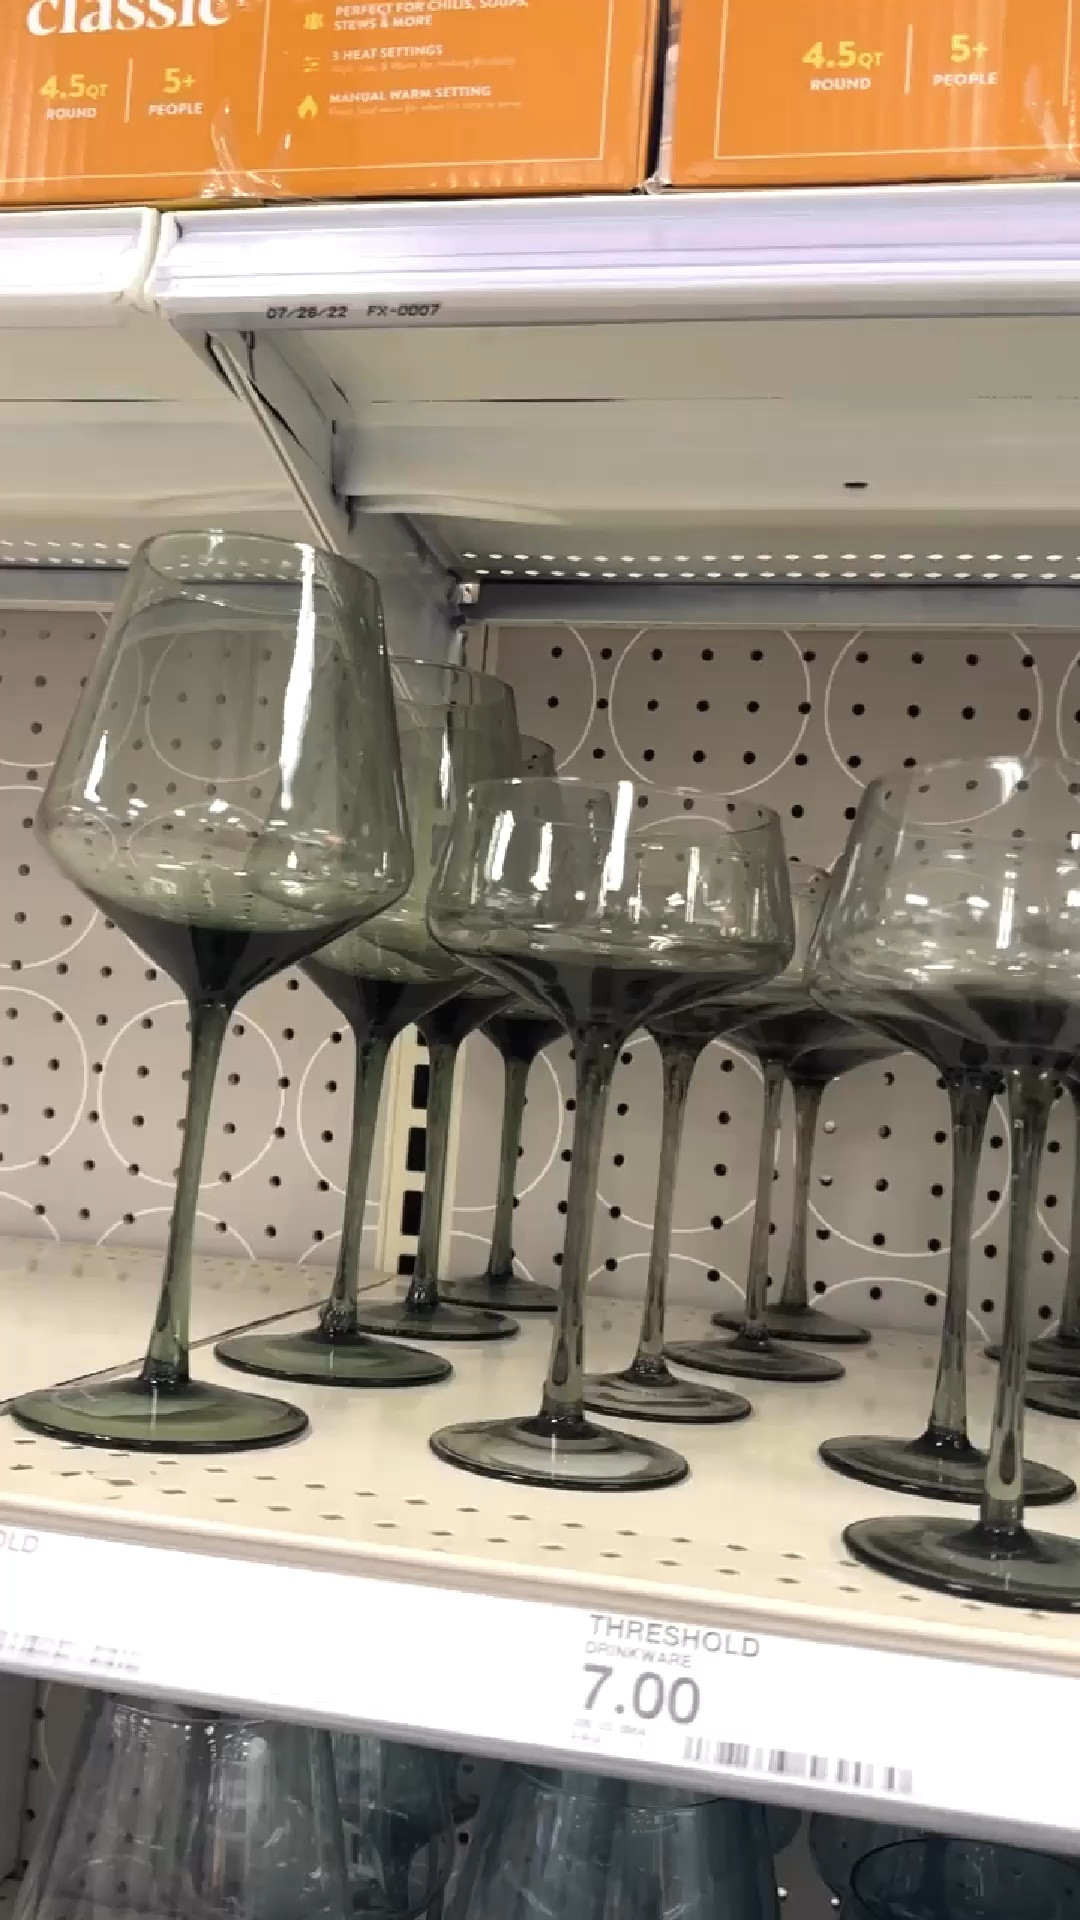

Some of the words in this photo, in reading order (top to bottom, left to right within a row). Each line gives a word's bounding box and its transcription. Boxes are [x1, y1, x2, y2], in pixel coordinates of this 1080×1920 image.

[26, 0, 229, 36] classic
[336, 3, 391, 17] PERFECT
[396, 0, 426, 13] FOR
[333, 19, 375, 31] STEWS
[393, 14, 432, 27] MORE
[332, 50, 341, 61] 3
[343, 48, 377, 60] HEAT
[380, 44, 443, 58] SETTINGS
[950, 34, 988, 62] 5+
[163, 67, 196, 94] 5+
[809, 77, 872, 91] ROUND
[933, 71, 998, 87] PEOPLE
[329, 91, 385, 103] MANUAL
[389, 88, 432, 101] WARM
[434, 85, 491, 98] SETTING
[46, 107, 97, 120] ROUND
[149, 102, 204, 116] PEOPLE
[590, 1614, 760, 1658] THRESHOLD
[585, 1641, 691, 1668] DRINKWARE
[583, 1663, 701, 1725] 7.00
